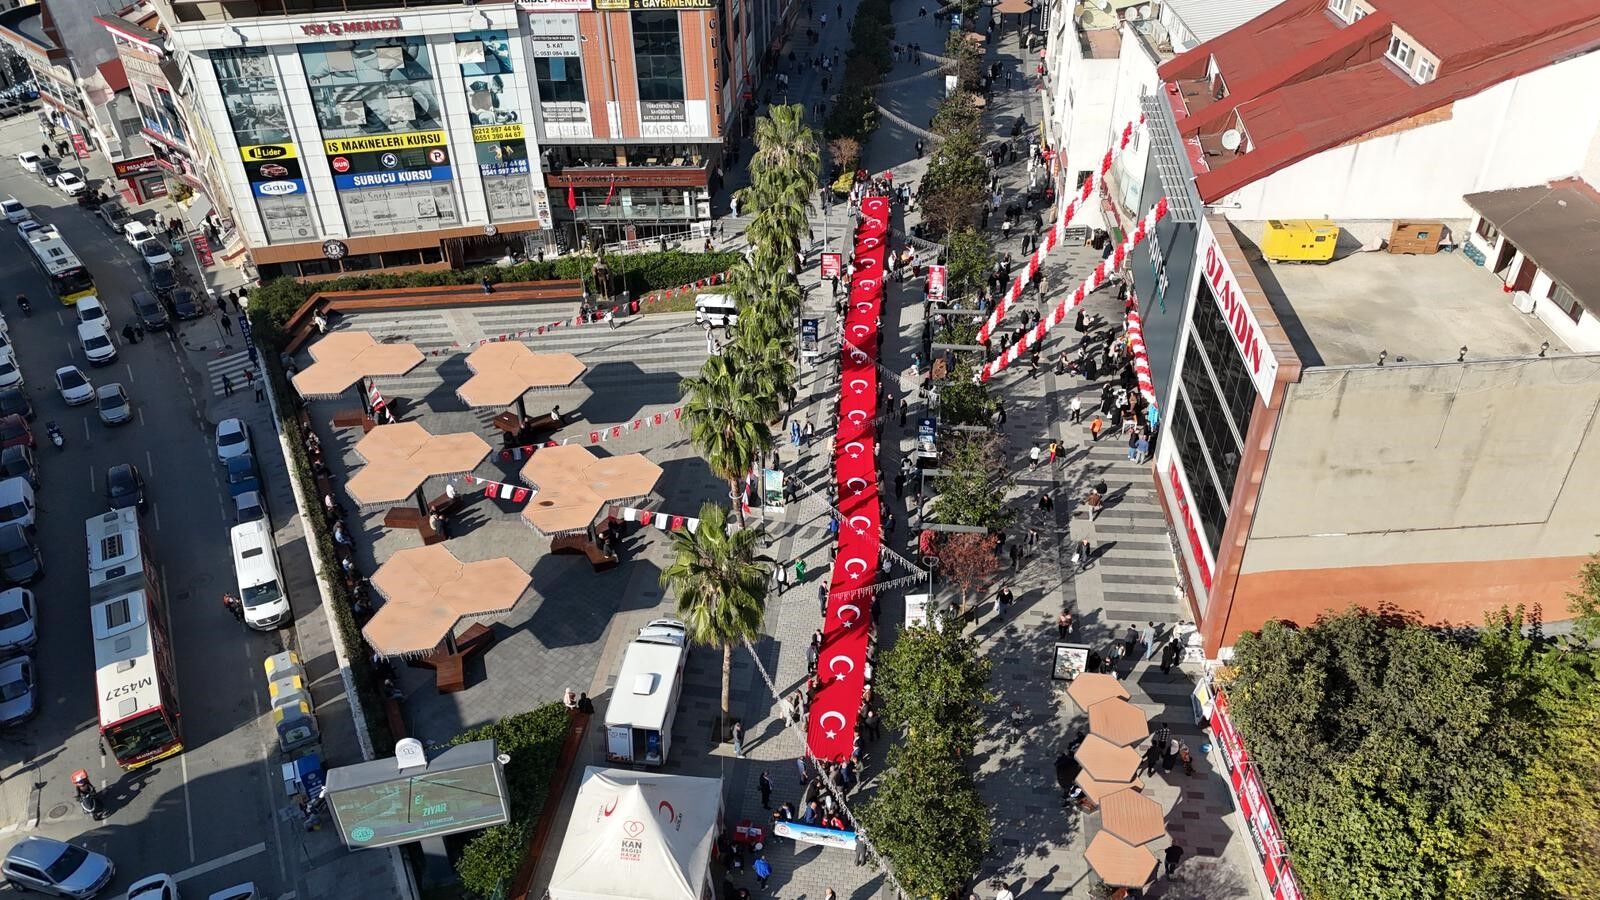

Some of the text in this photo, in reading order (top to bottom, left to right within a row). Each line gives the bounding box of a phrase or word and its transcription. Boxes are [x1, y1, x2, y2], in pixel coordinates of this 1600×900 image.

[406, 133, 441, 145] KURSU
[398, 169, 433, 182] KURSU
[262, 184, 294, 192] Gaye
[1205, 239, 1264, 375] ÖZAYDIN
[106, 676, 152, 701] M4527
[621, 840, 642, 849] KAN
